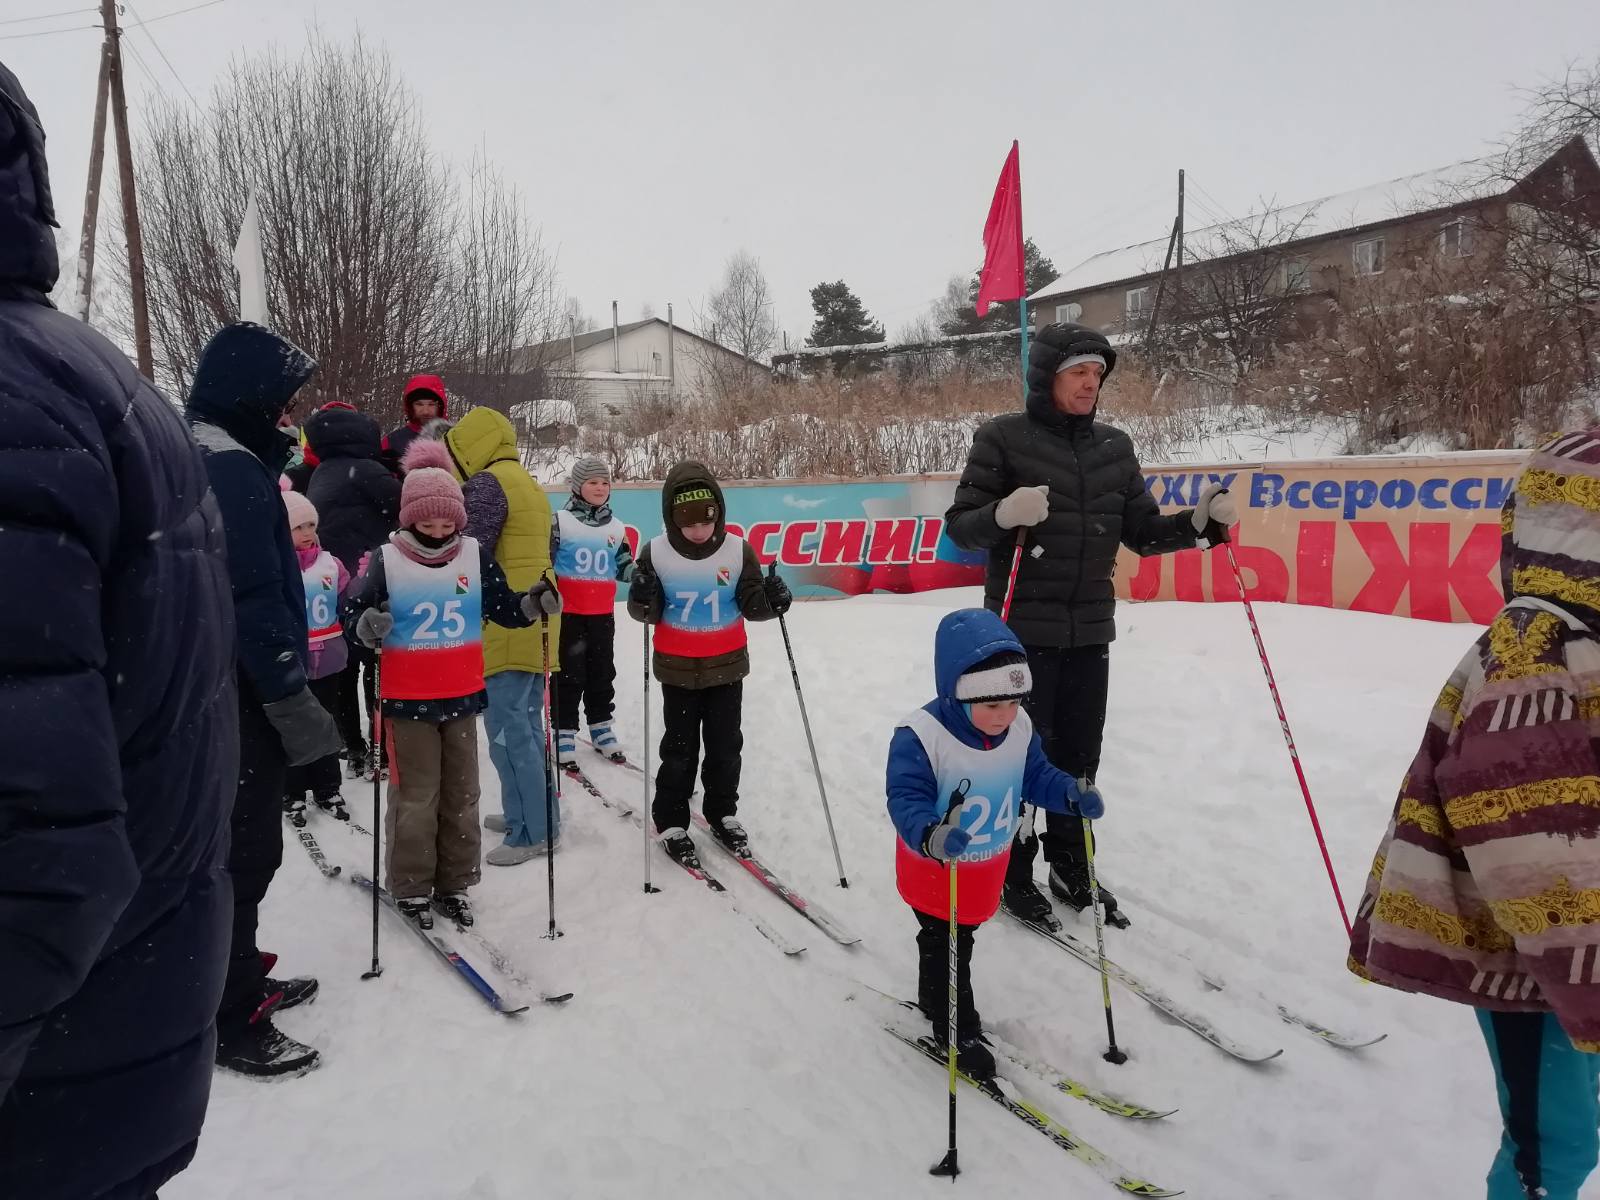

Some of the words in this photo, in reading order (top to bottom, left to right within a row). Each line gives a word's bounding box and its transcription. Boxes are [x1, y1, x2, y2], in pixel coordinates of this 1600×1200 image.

[575, 547, 609, 575] 90
[306, 594, 329, 624] 6
[412, 600, 466, 639] 25
[676, 590, 720, 623] 71
[961, 786, 1014, 846] 24
